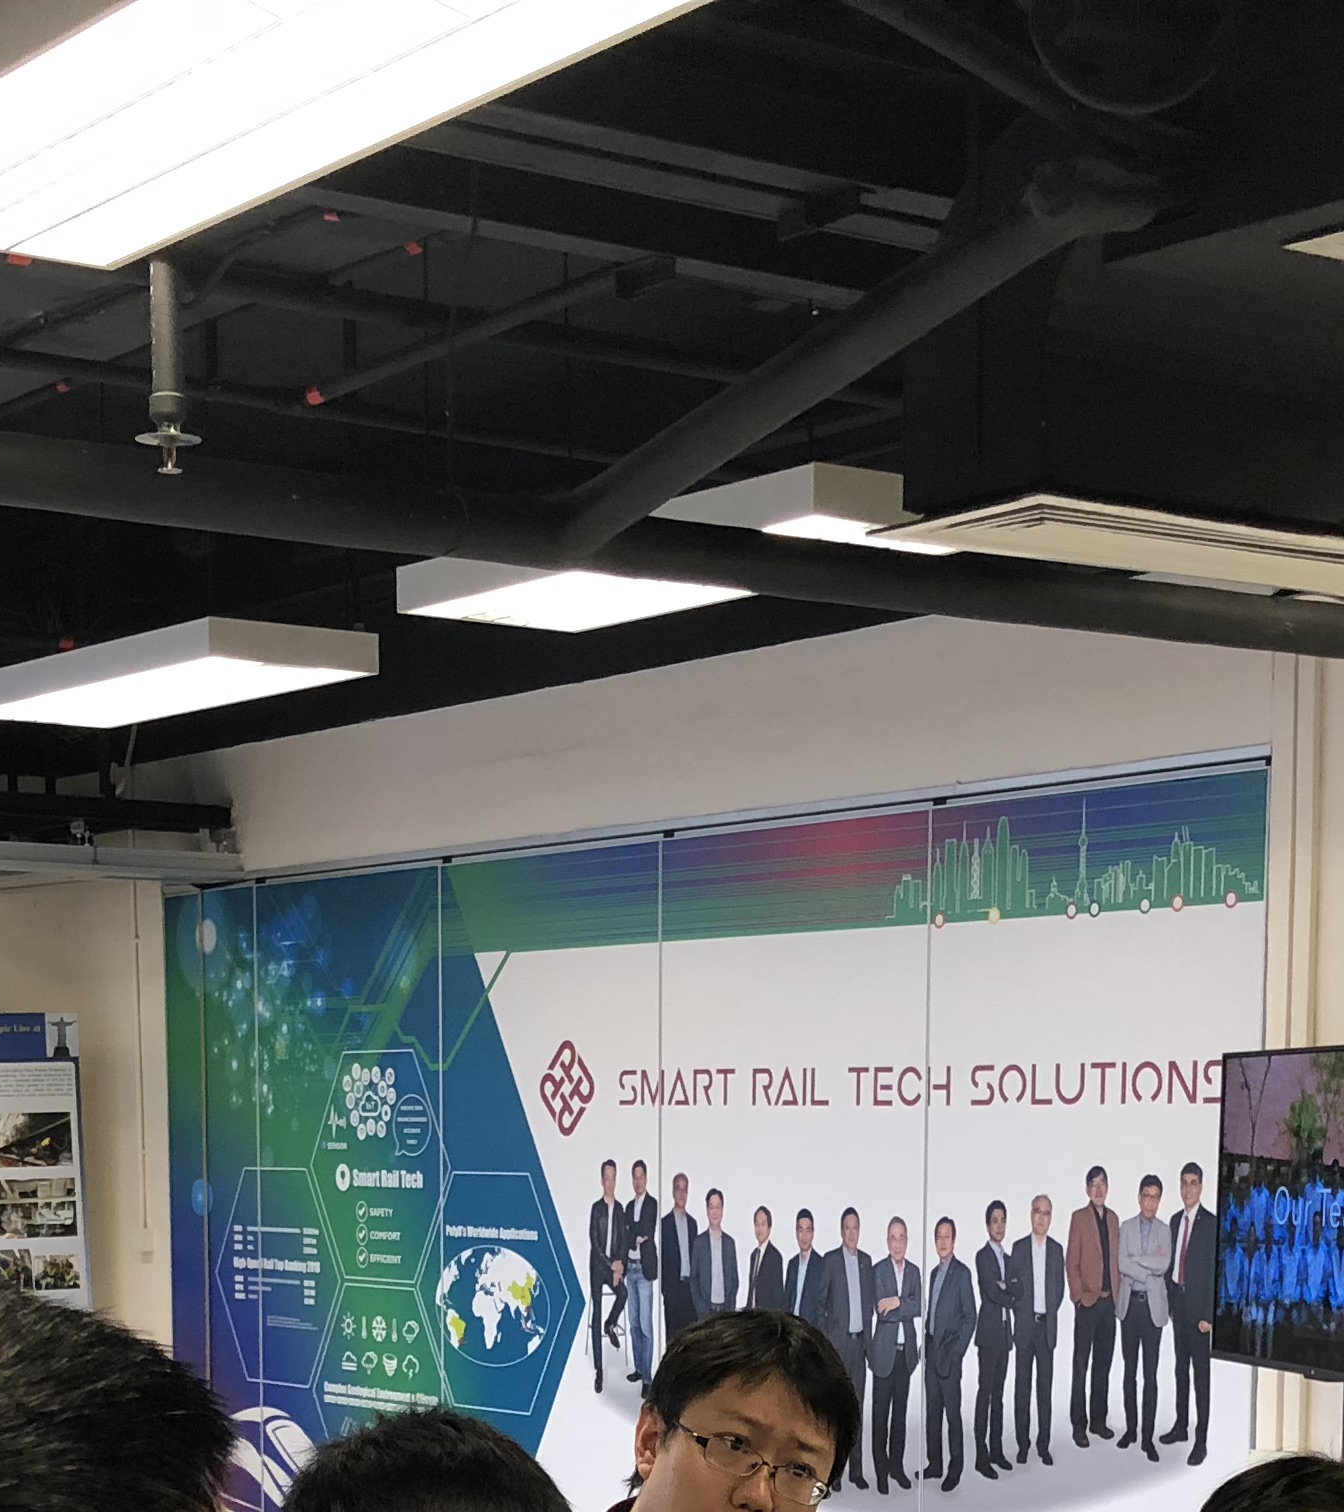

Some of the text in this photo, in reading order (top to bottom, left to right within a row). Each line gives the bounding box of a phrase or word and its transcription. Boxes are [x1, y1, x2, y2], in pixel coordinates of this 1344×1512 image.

[618, 1066, 736, 1107] SMART
[751, 1066, 830, 1107] RAIL
[848, 1065, 952, 1107] TECH
[352, 1168, 423, 1188] Smart Rail Tech
[369, 1207, 393, 1218] SAFETY
[1274, 1186, 1312, 1226] Our
[369, 1231, 401, 1241] COMFORT
[369, 1254, 402, 1264] EFFICIENT
